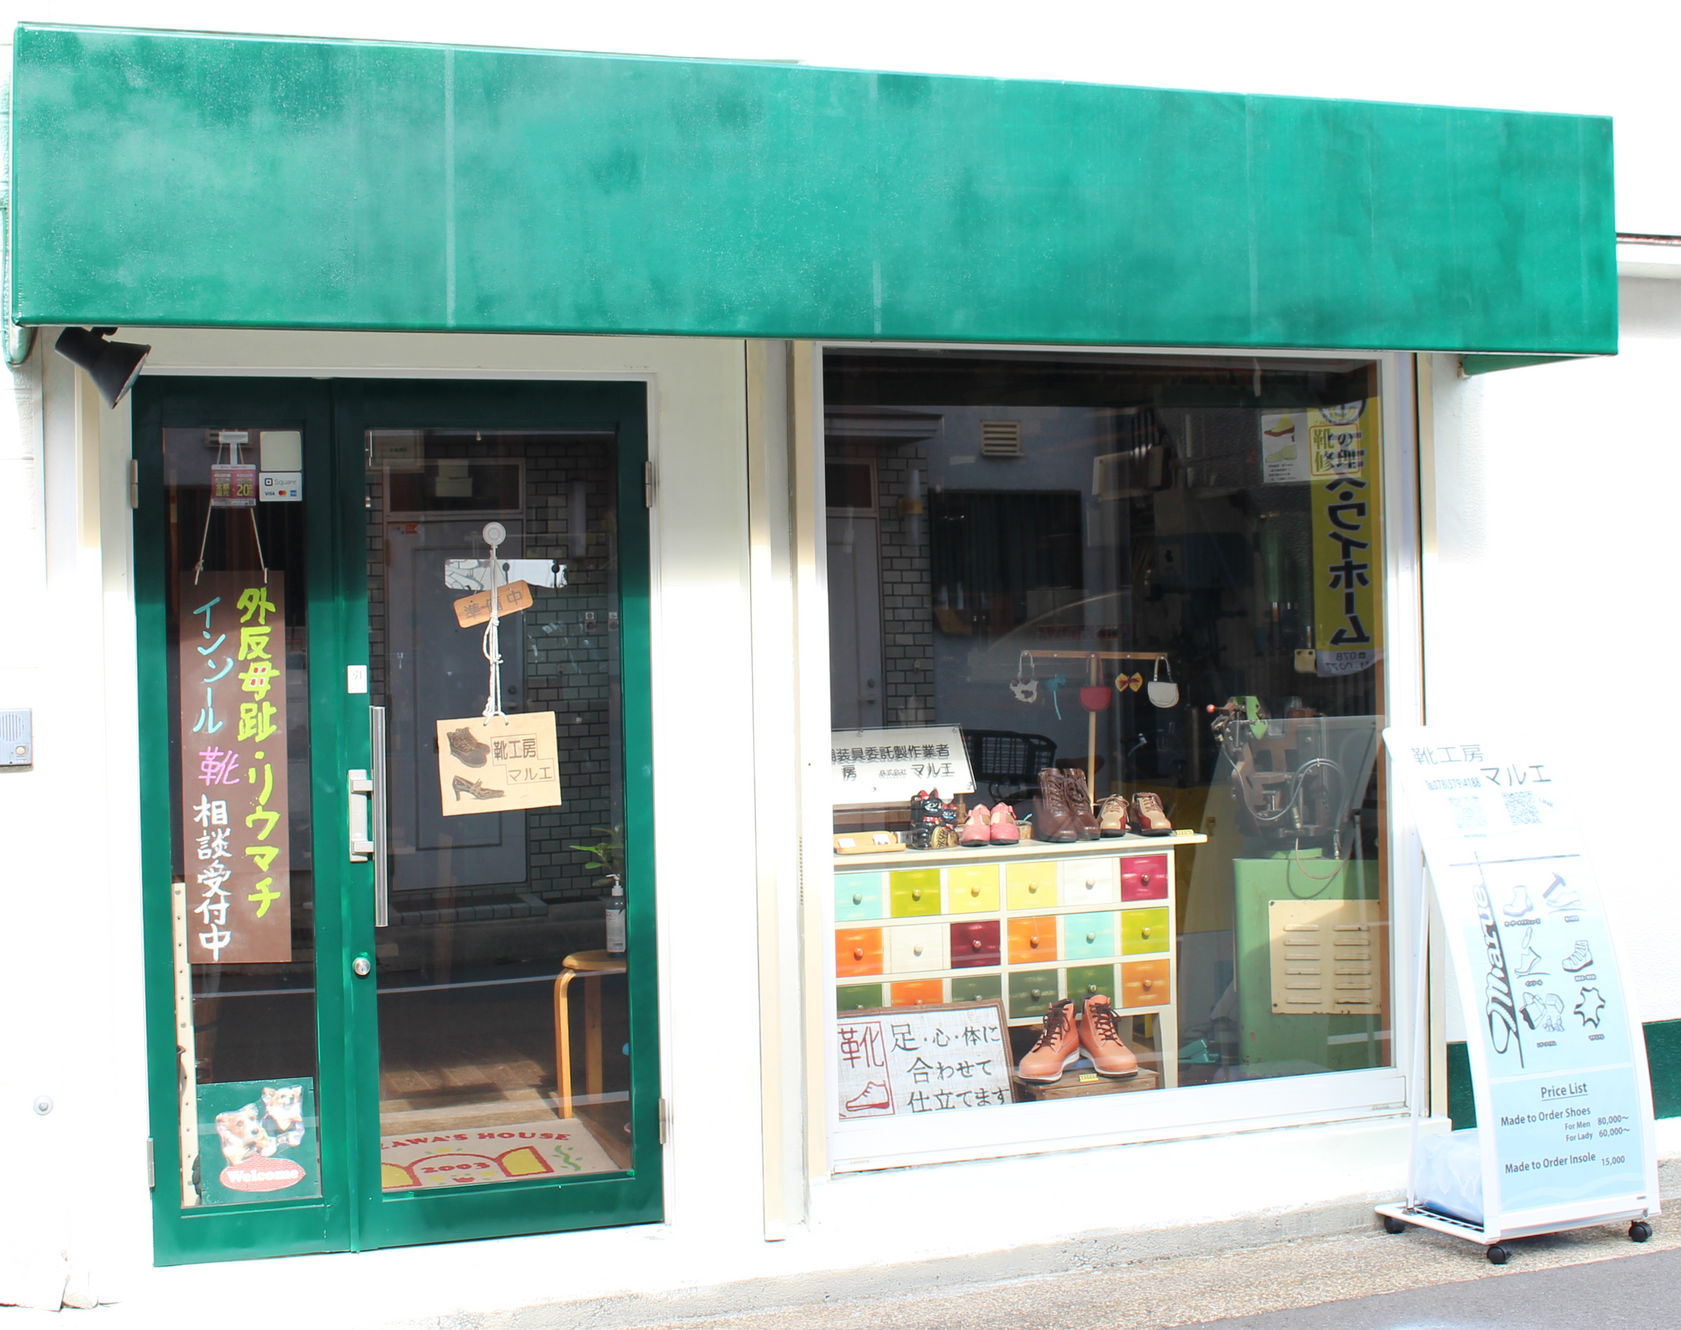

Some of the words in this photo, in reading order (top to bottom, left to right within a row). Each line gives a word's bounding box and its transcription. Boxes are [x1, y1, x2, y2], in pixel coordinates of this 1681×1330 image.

[193, 596, 234, 734] インソール
[236, 587, 281, 918] 外反母趾・リウマチ
[492, 738, 537, 761] 靴工房
[1411, 744, 1484, 765] 靴工房
[198, 746, 240, 786] 靴
[507, 766, 553, 783] マルエ
[842, 764, 857, 781] 房
[910, 762, 955, 779] マルエ
[1480, 764, 1552, 787] マルエ
[192, 793, 233, 962] 相談受付中
[837, 1025, 885, 1069] 靴
[890, 1022, 1001, 1053] 足・心・体に
[906, 1056, 993, 1085] 合わせて
[906, 1087, 1011, 1114] 仕立てます
[1540, 1086, 1567, 1098] Price
[1569, 1082, 1588, 1094] List
[1500, 1115, 1526, 1126] Made
[1527, 1114, 1537, 1122] to
[1538, 1110, 1564, 1121] Order
[1565, 1106, 1591, 1117] Shoes
[1576, 1120, 1591, 1128] Men
[477, 1131, 572, 1142] HOUSE
[1577, 1131, 1594, 1140] Lady
[420, 1161, 491, 1175] 2003
[1504, 1162, 1530, 1173] Made
[1531, 1161, 1542, 1169] to
[1542, 1157, 1568, 1168] Order
[1569, 1151, 1596, 1163] Insole
[1600, 1155, 1626, 1166] 15,000
[226, 1169, 300, 1183] Welcome
